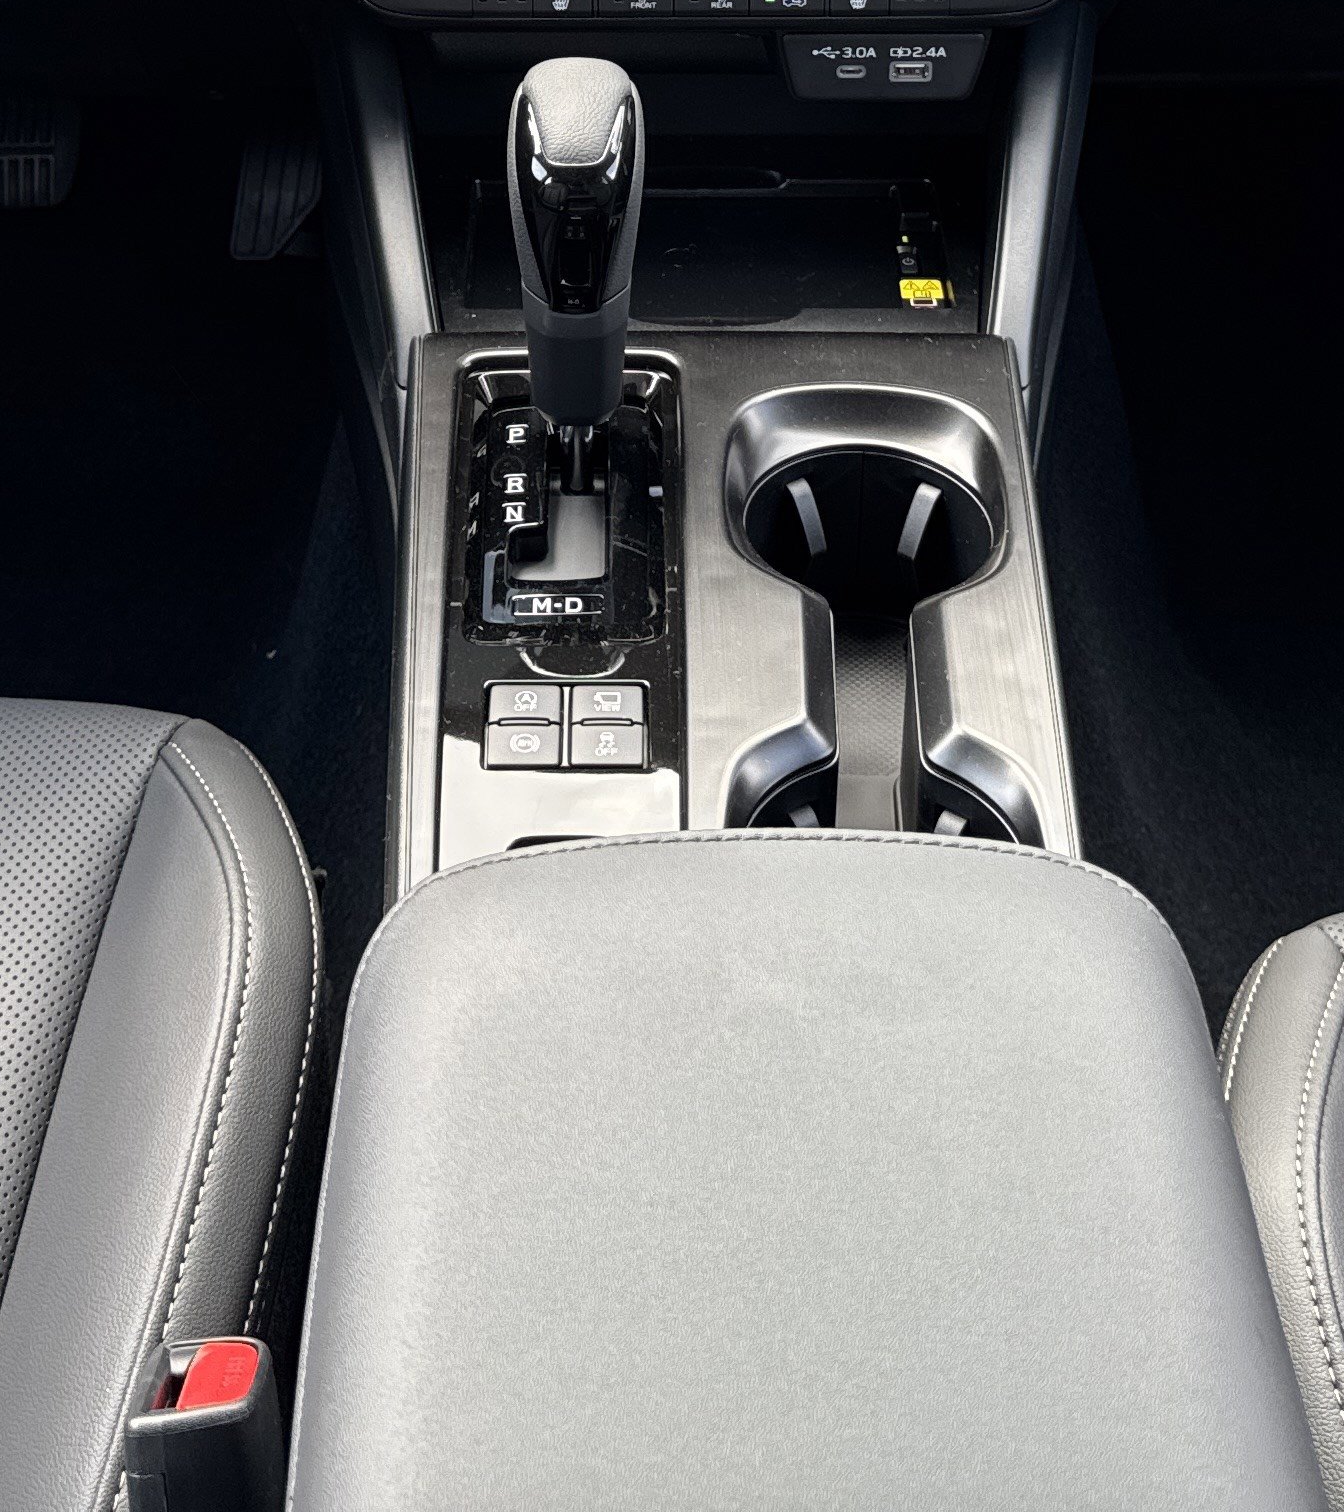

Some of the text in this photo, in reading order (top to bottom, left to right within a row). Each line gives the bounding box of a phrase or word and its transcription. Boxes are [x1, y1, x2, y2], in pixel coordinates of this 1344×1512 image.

[630, 1, 657, 9] FRONT
[710, 1, 733, 9] REAR
[841, 46, 877, 58] 3.0A
[912, 46, 947, 58] 2.4A
[508, 426, 525, 442] P
[506, 476, 524, 491] R
[506, 506, 523, 521] N
[531, 598, 584, 614] M-D
[513, 704, 537, 712] OFF
[593, 704, 621, 712] VIEW
[594, 748, 618, 756] OFF
